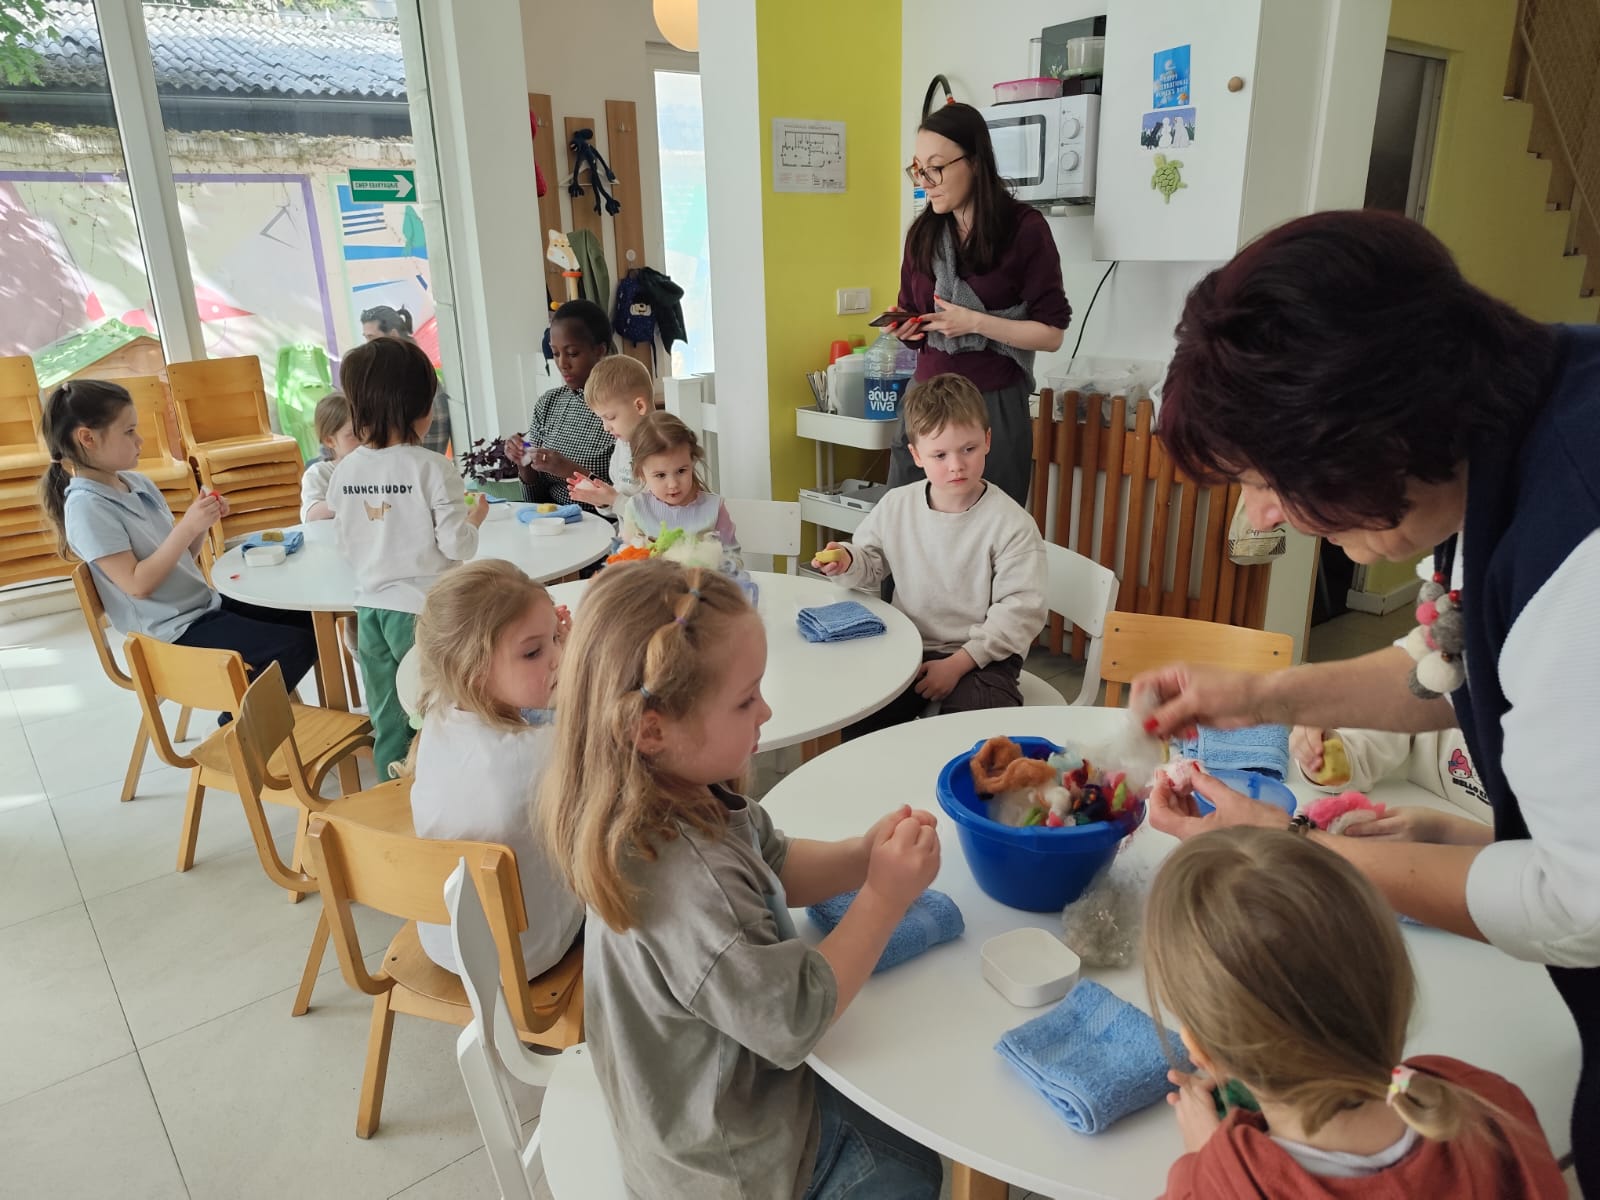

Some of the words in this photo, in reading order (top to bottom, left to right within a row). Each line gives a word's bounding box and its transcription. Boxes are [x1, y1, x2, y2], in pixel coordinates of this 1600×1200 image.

[870, 400, 895, 412] viva
[342, 485, 379, 495] BRUNCH
[1452, 777, 1479, 793] HELLO
